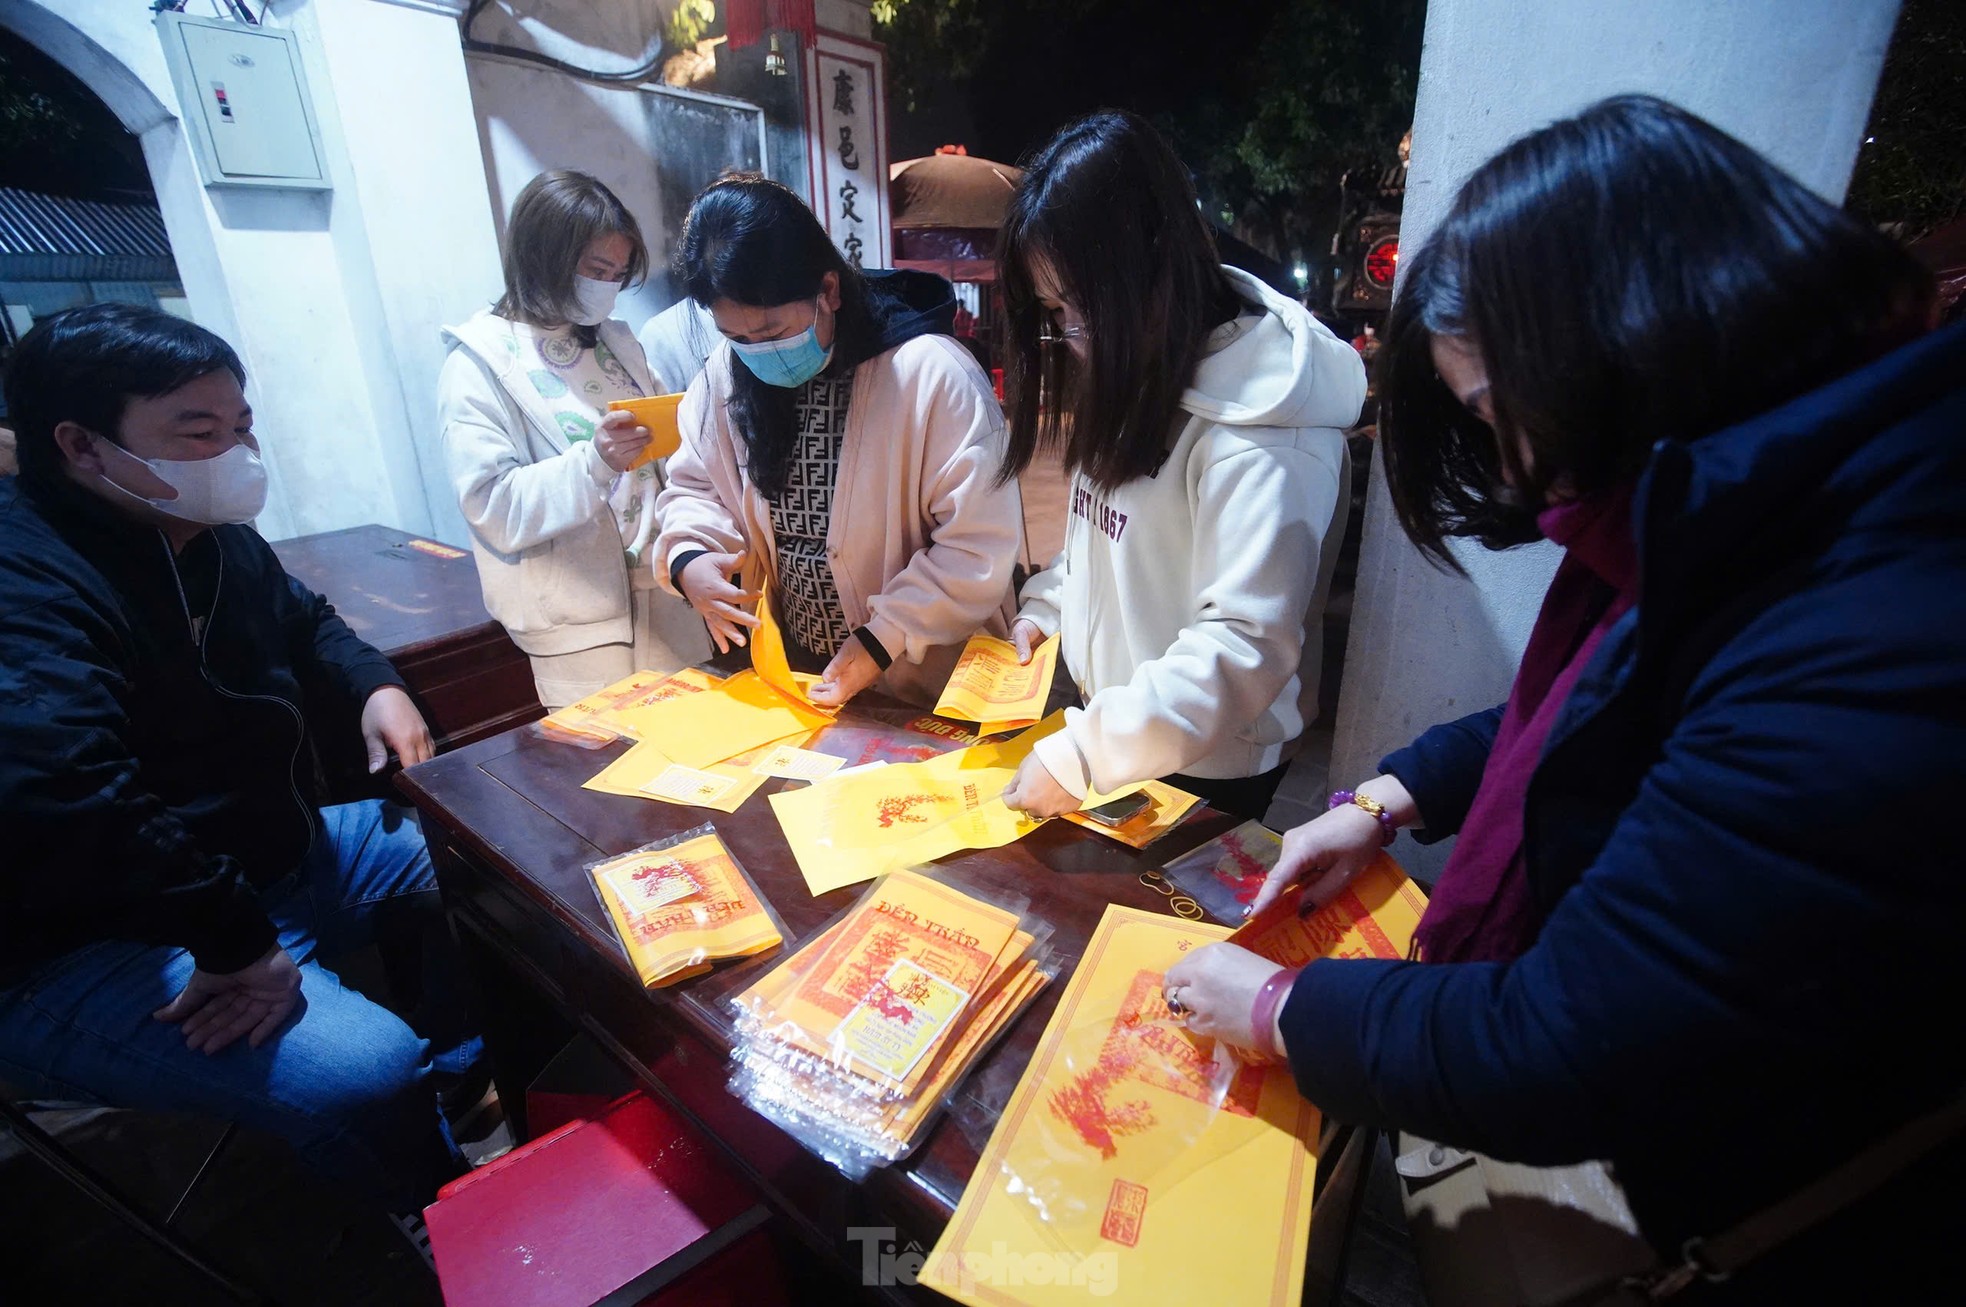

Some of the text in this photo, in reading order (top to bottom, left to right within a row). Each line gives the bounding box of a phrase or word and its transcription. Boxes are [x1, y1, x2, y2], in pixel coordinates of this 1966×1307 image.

[1100, 502, 1128, 543] 1867
[876, 900, 981, 951] ĐỀN TRẦN
